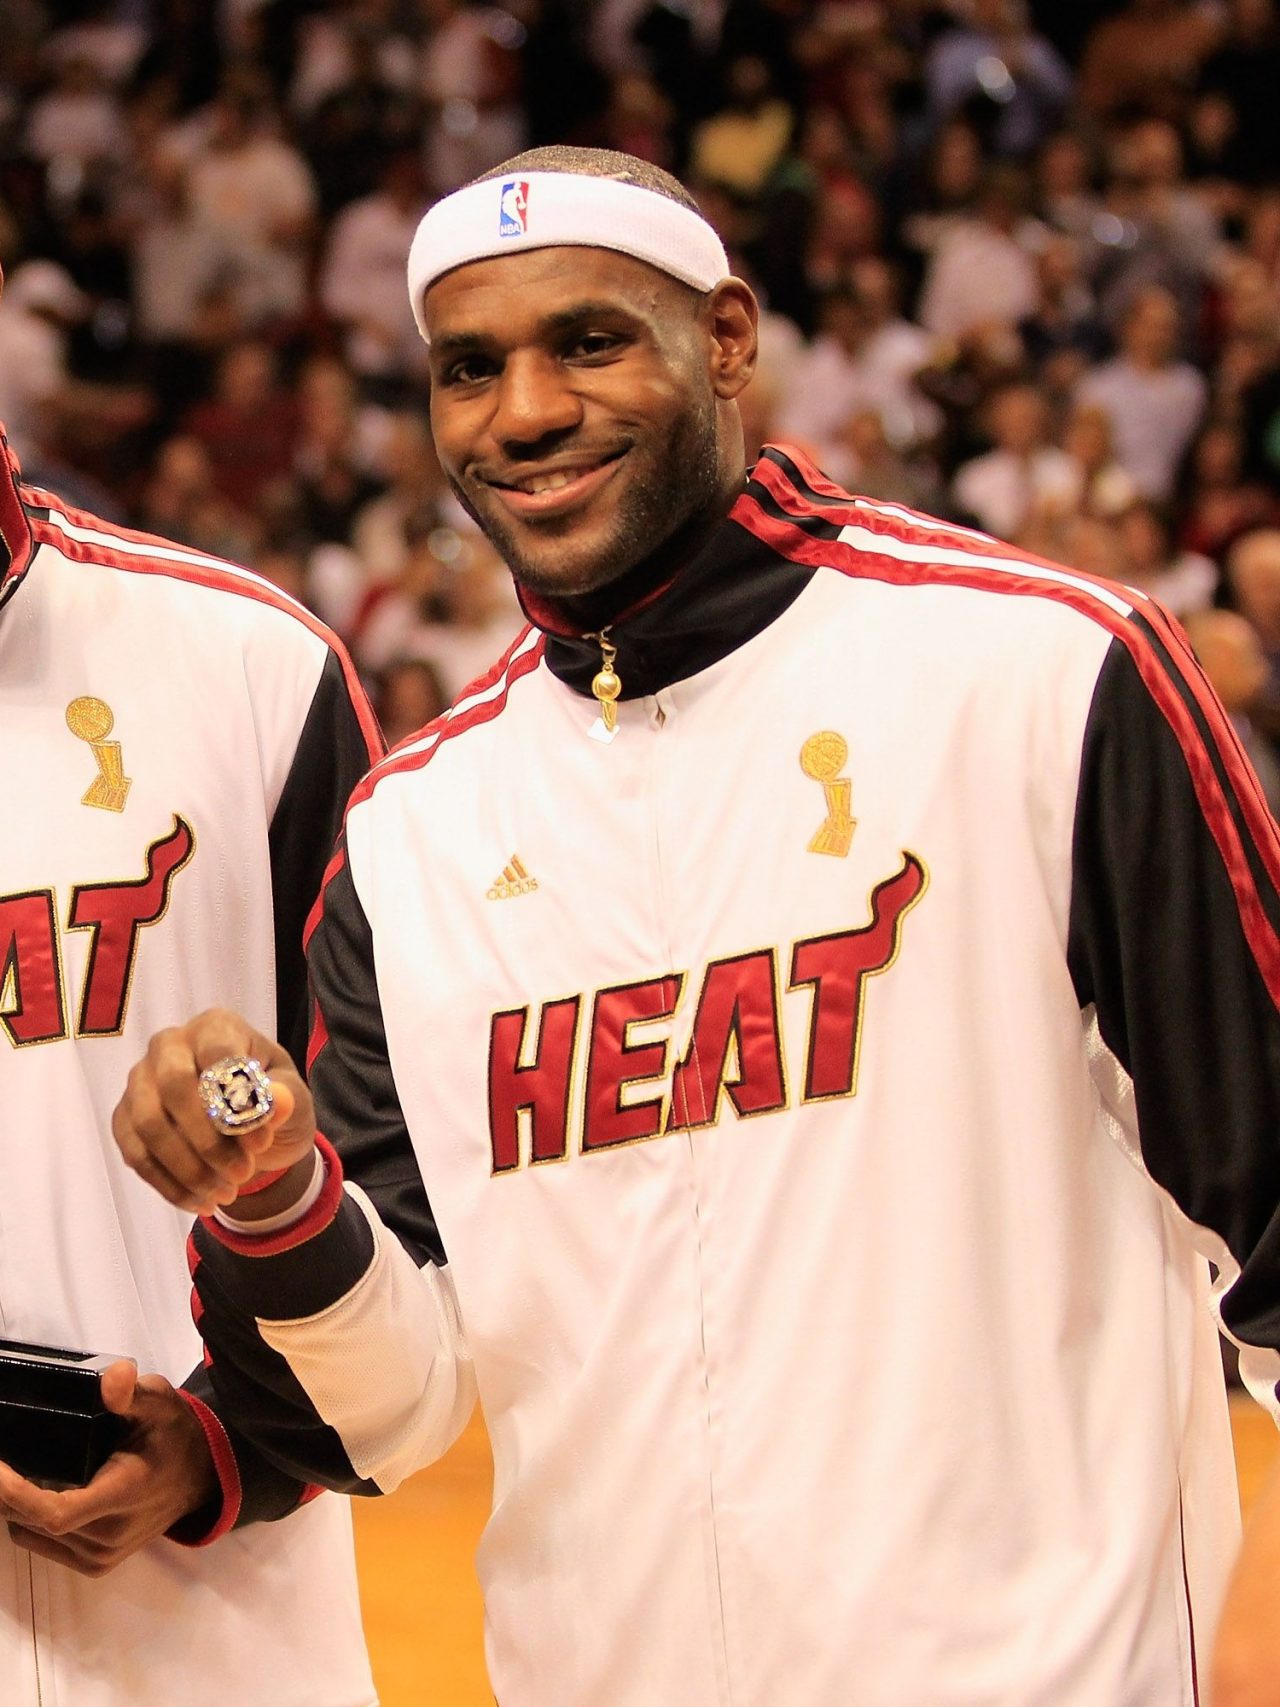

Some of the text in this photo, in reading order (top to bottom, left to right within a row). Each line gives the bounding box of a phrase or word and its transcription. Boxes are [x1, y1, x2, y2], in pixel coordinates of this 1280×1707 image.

[500, 224, 521, 235] NBA
[486, 877, 539, 901] adidas
[487, 848, 931, 1179] HEAT
